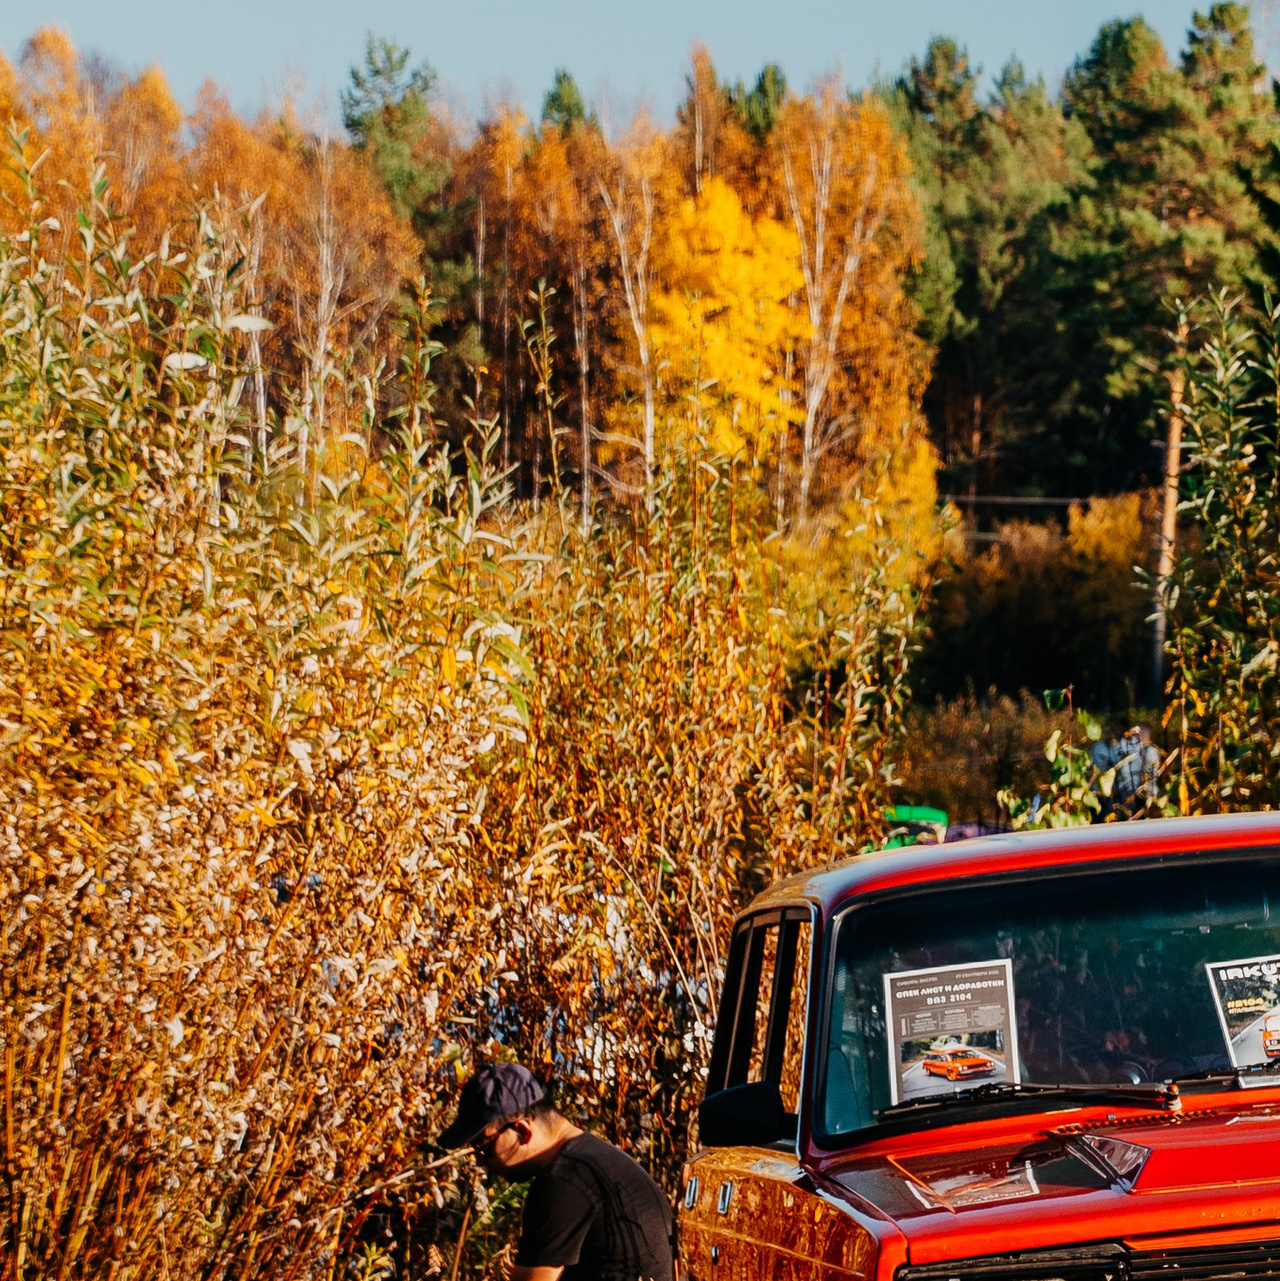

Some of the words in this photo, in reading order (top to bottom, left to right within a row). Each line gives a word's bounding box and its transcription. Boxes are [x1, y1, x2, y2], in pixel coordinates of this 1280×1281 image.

[921, 985, 944, 996] ЛИСТ
[944, 985, 952, 993] И
[952, 980, 1005, 991] ДОРАБОТКИ
[926, 995, 946, 1005] ВАЗ
[949, 992, 972, 1003] 2104
